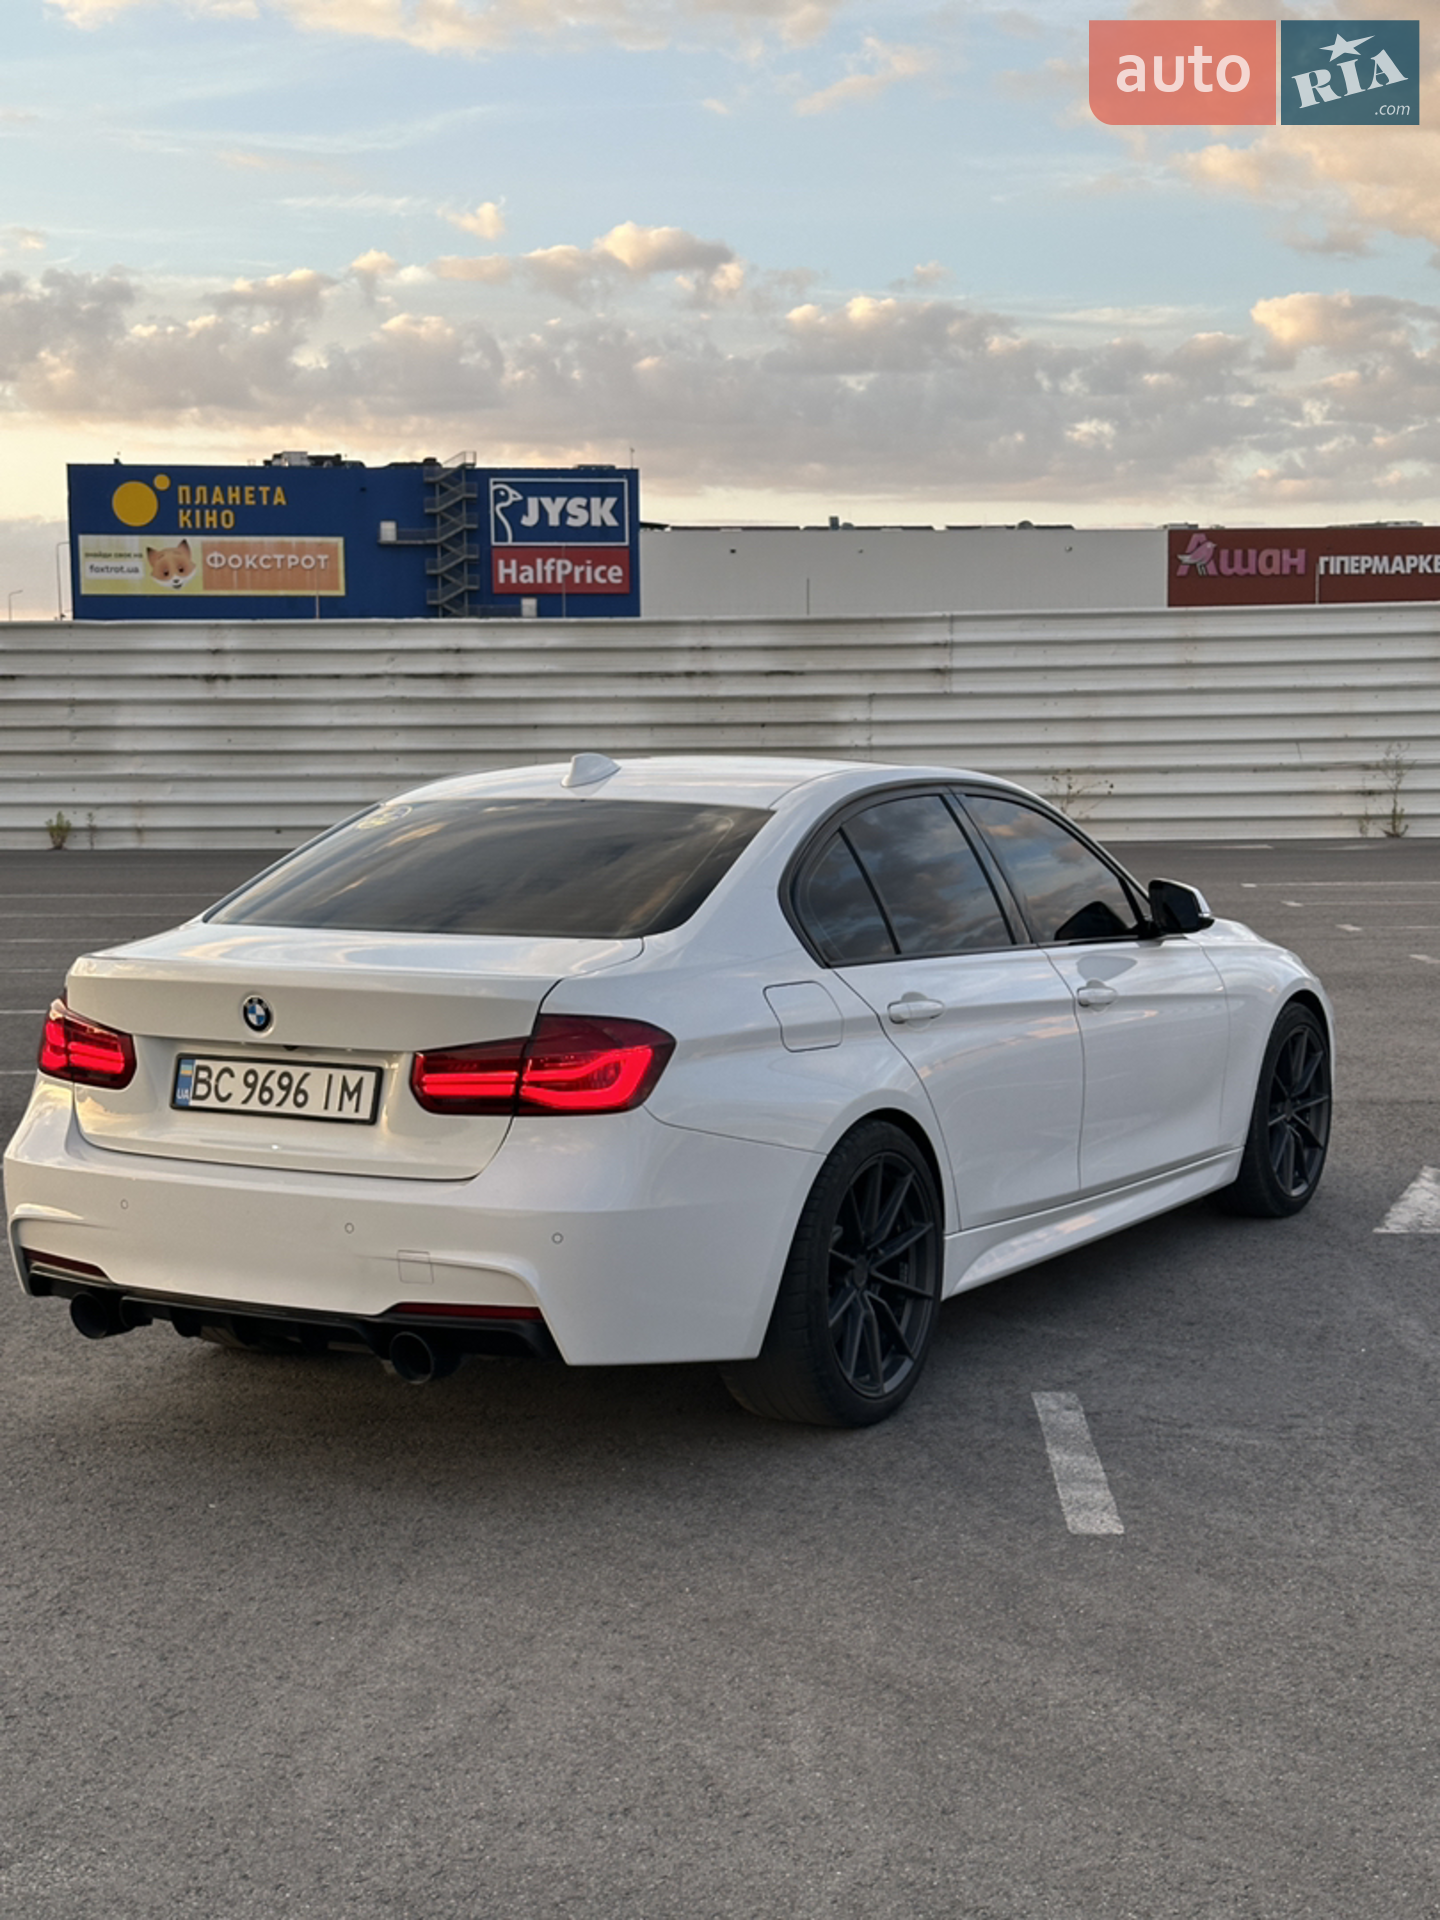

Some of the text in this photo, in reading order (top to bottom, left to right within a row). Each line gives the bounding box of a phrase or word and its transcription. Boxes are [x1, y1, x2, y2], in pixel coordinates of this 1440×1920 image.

[177, 485, 287, 506] ПЛАНЕТА
[178, 509, 235, 529] КІНО
[520, 497, 619, 527] JYSK
[89, 563, 140, 574] foxtrot.ua
[205, 551, 329, 570] ФОКСТРОТ
[498, 558, 623, 584] HalfPrice
[176, 1088, 191, 1100] UA
[192, 1065, 364, 1113] BC 9696 IM
